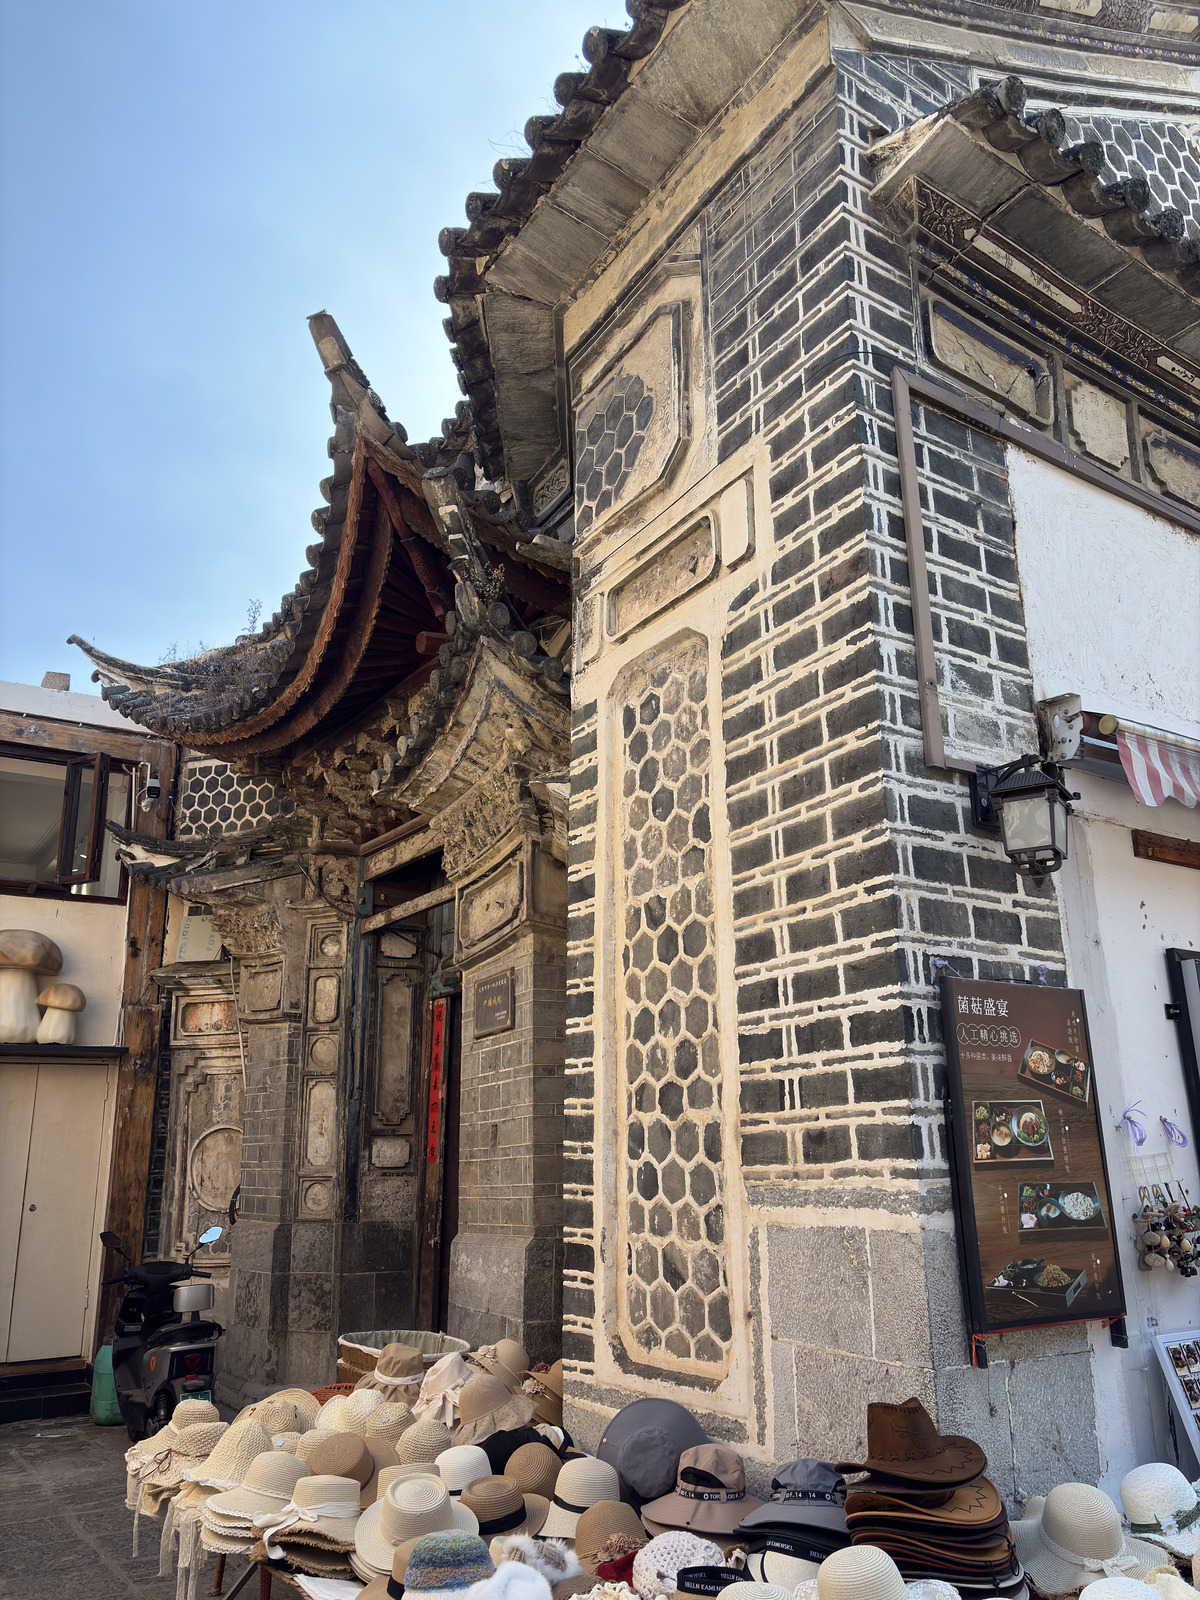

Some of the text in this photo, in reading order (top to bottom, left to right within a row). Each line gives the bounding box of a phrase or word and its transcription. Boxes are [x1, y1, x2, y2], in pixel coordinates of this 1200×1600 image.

[957, 995, 1008, 1017] 菌菇盛宴
[960, 1027, 1018, 1043] 人工精心挑选
